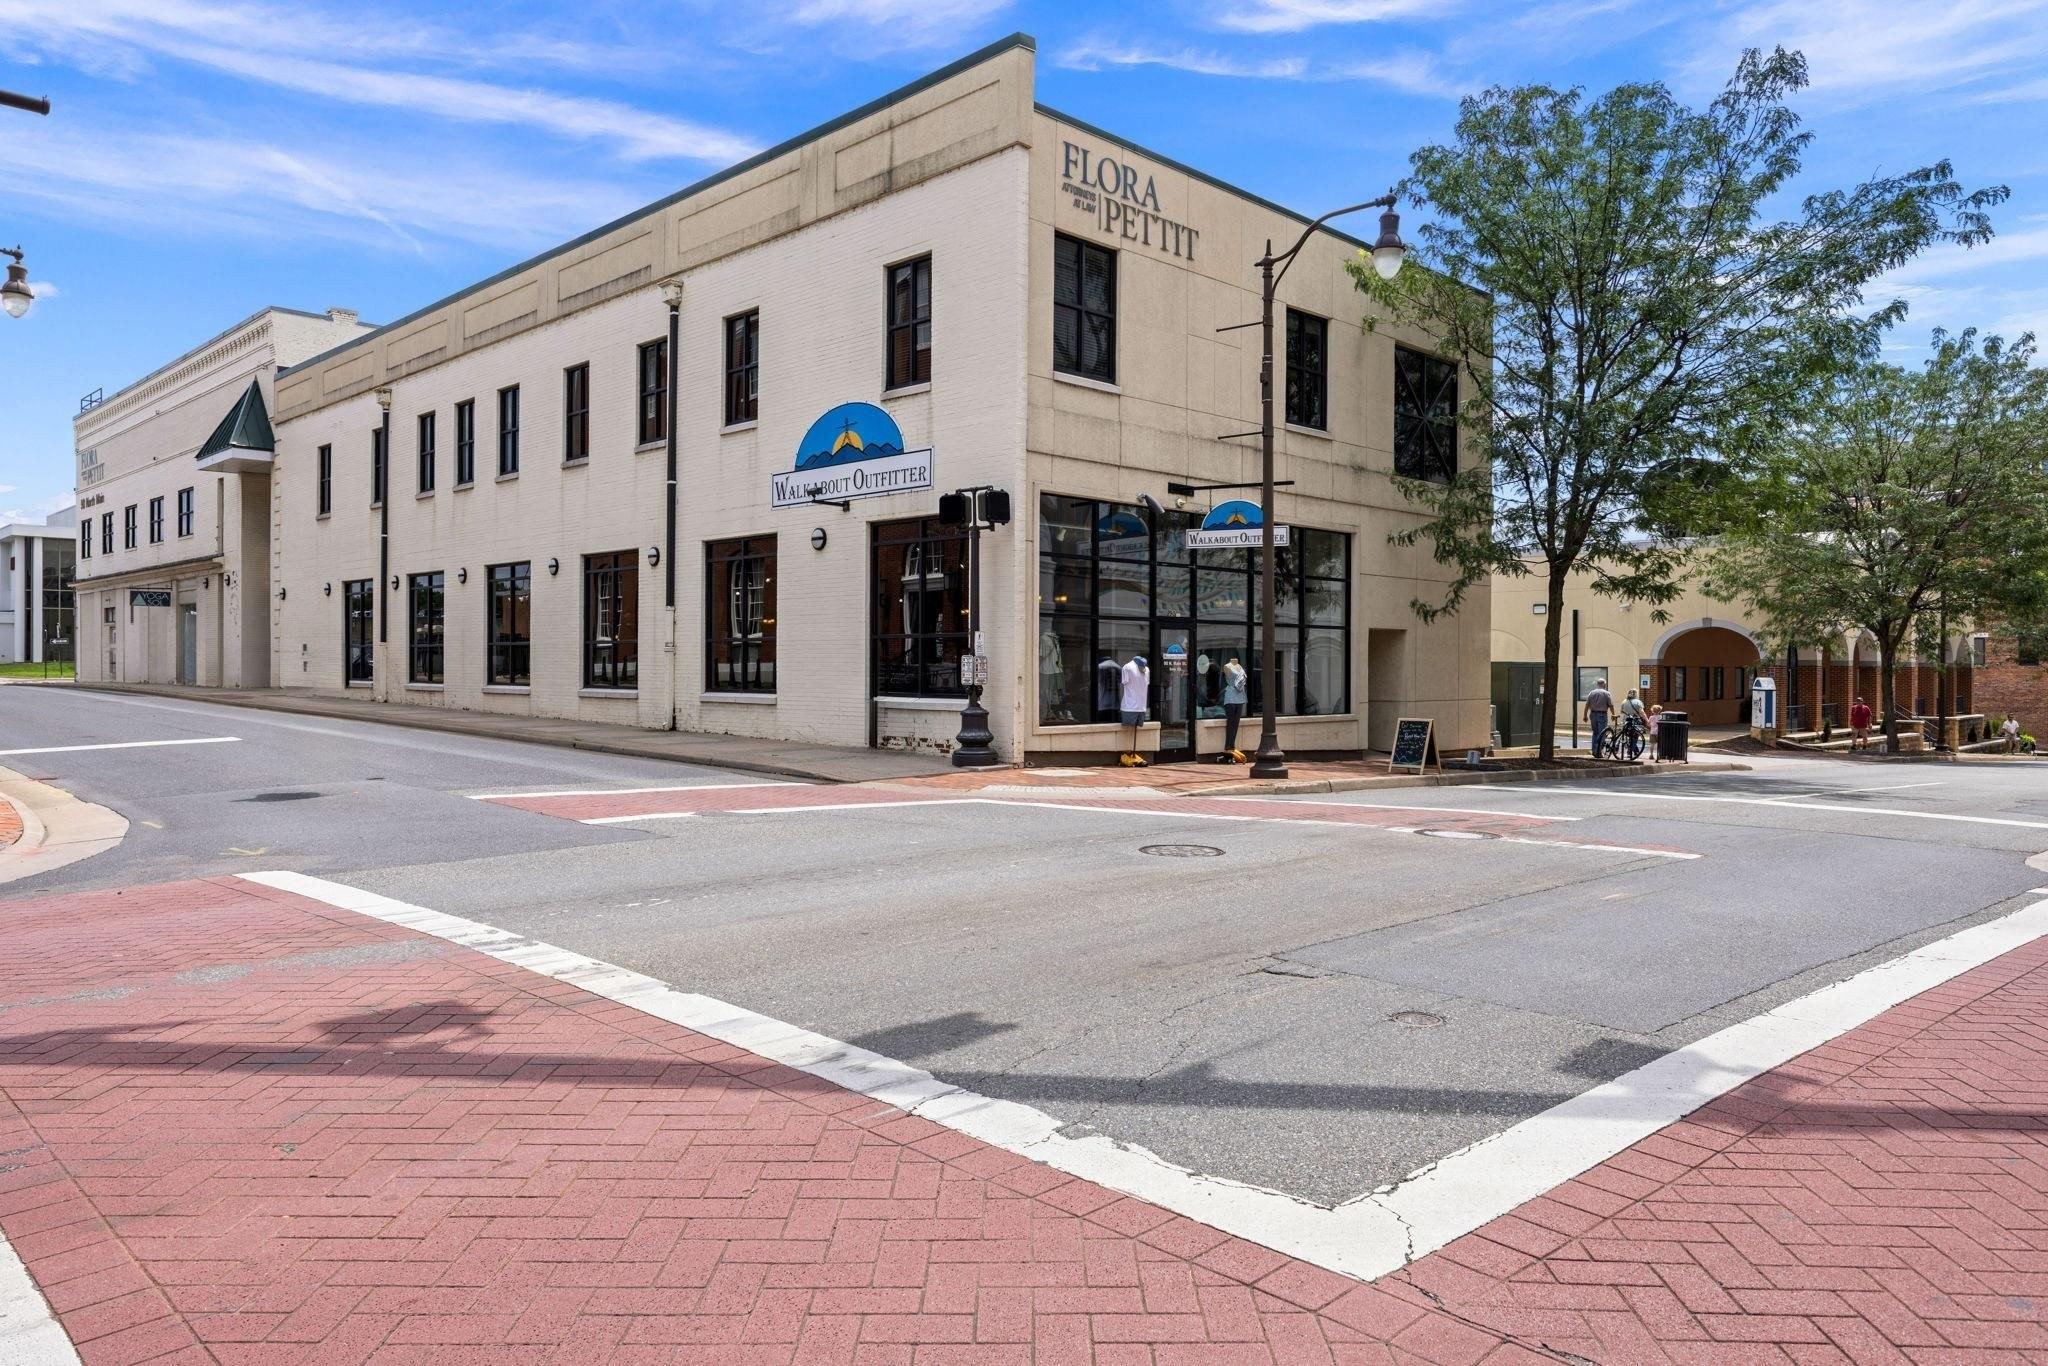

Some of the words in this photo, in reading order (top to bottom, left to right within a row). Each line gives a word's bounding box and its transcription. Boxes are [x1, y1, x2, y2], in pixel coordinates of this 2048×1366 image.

[1062, 141, 1161, 212] FLORA
[1062, 182, 1097, 202] ATTORNEYS
[1081, 200, 1097, 213] LAW
[1104, 197, 1200, 261] PETTIT
[853, 465, 926, 490] OUTFITTER
[1189, 531, 1238, 545] WALKABOUT
[1240, 531, 1285, 544] OUTFER
[142, 592, 169, 600] YOGA
